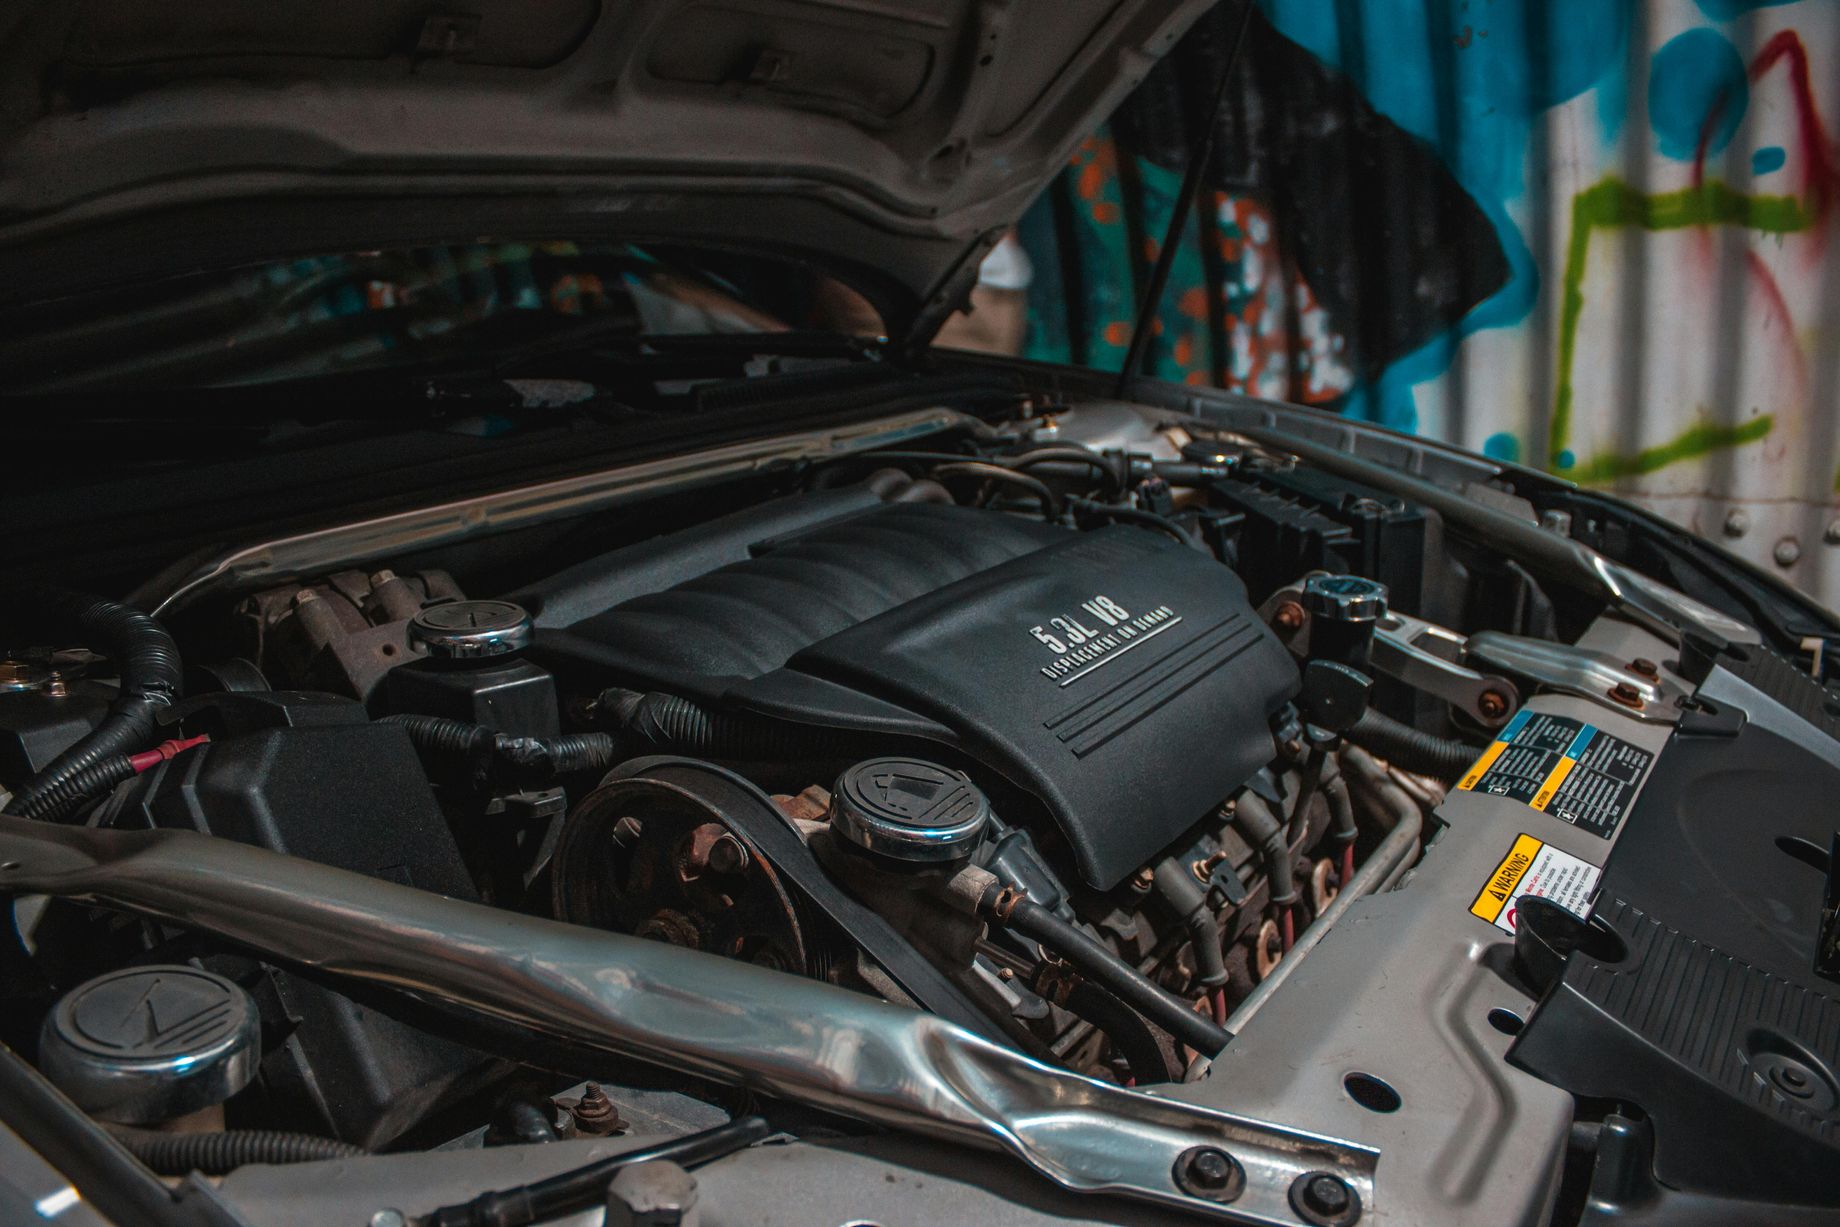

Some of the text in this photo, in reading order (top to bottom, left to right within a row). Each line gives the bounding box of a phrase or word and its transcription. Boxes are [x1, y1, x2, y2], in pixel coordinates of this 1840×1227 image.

[1029, 595, 1130, 655] 5.3L V8
[1041, 605, 1175, 680] DISPLACEMENT ON DEMAND
[1494, 853, 1529, 891] WARNING
